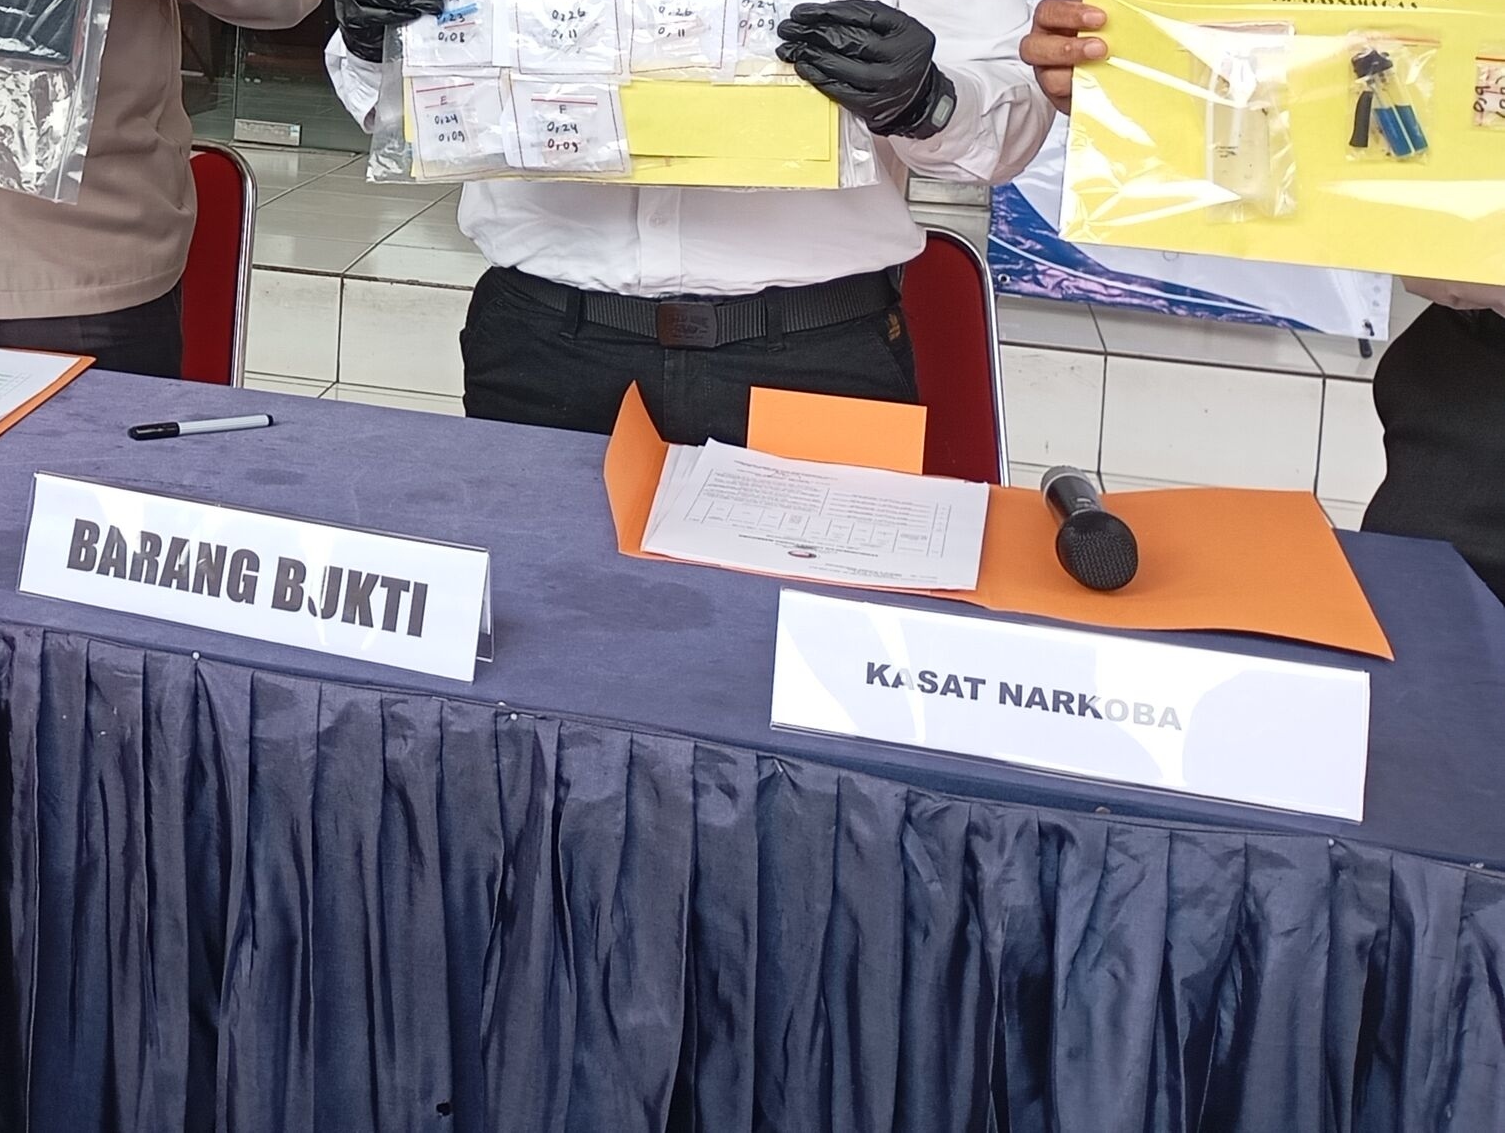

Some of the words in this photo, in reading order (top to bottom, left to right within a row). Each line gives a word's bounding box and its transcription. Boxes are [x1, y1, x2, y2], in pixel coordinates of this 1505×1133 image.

[66, 518, 261, 605] BARANG
[271, 556, 429, 638] BUKTI
[865, 661, 987, 701] KASAT
[998, 683, 1183, 731] NARKOBA
